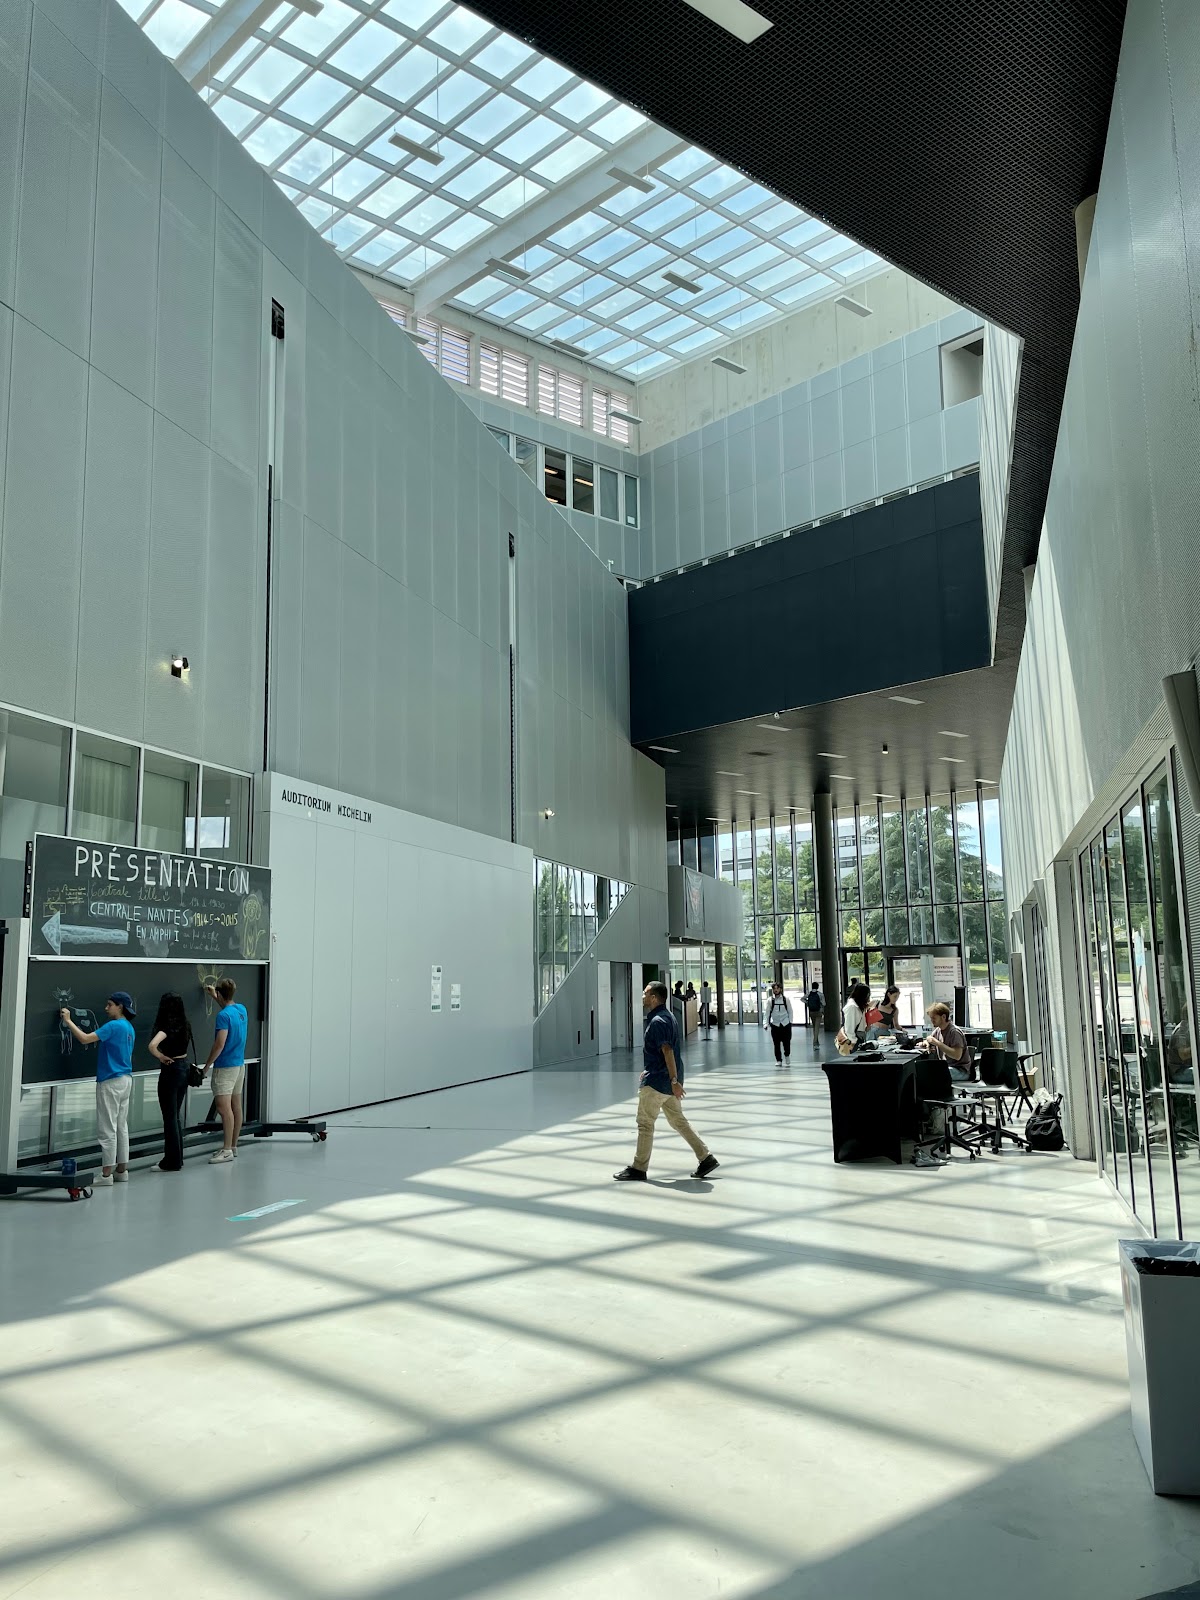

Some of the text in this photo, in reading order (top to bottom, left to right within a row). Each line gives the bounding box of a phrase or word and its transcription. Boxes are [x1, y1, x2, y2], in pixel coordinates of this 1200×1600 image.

[282, 789, 372, 823] AUDITORIUM MICHELIN
[75, 846, 250, 895] PRÉSENTATION
[90, 902, 143, 921] CENTRALE
[147, 906, 190, 927] NANTES
[136, 925, 147, 939] EN
[149, 927, 171, 942] AMPHI
